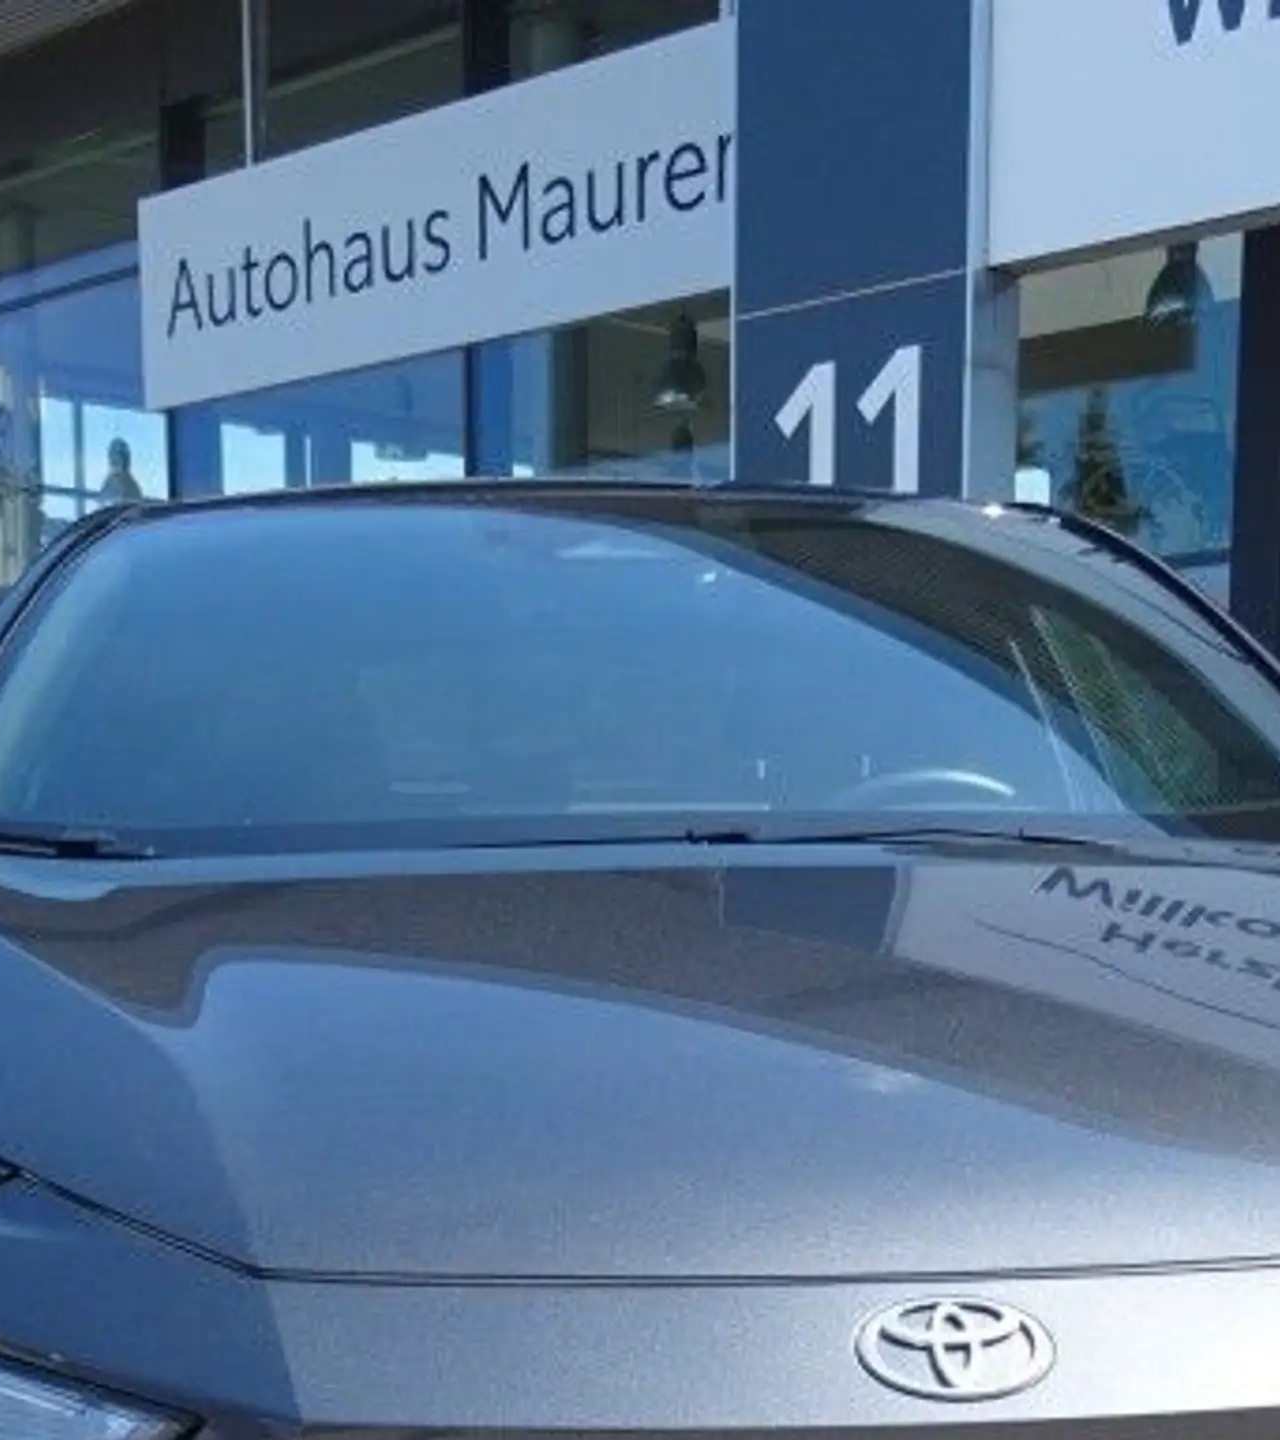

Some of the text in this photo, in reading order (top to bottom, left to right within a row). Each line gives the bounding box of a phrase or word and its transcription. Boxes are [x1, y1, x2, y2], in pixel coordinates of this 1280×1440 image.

[166, 134, 732, 339] Autohaus Maurer
[774, 344, 922, 494] 11
